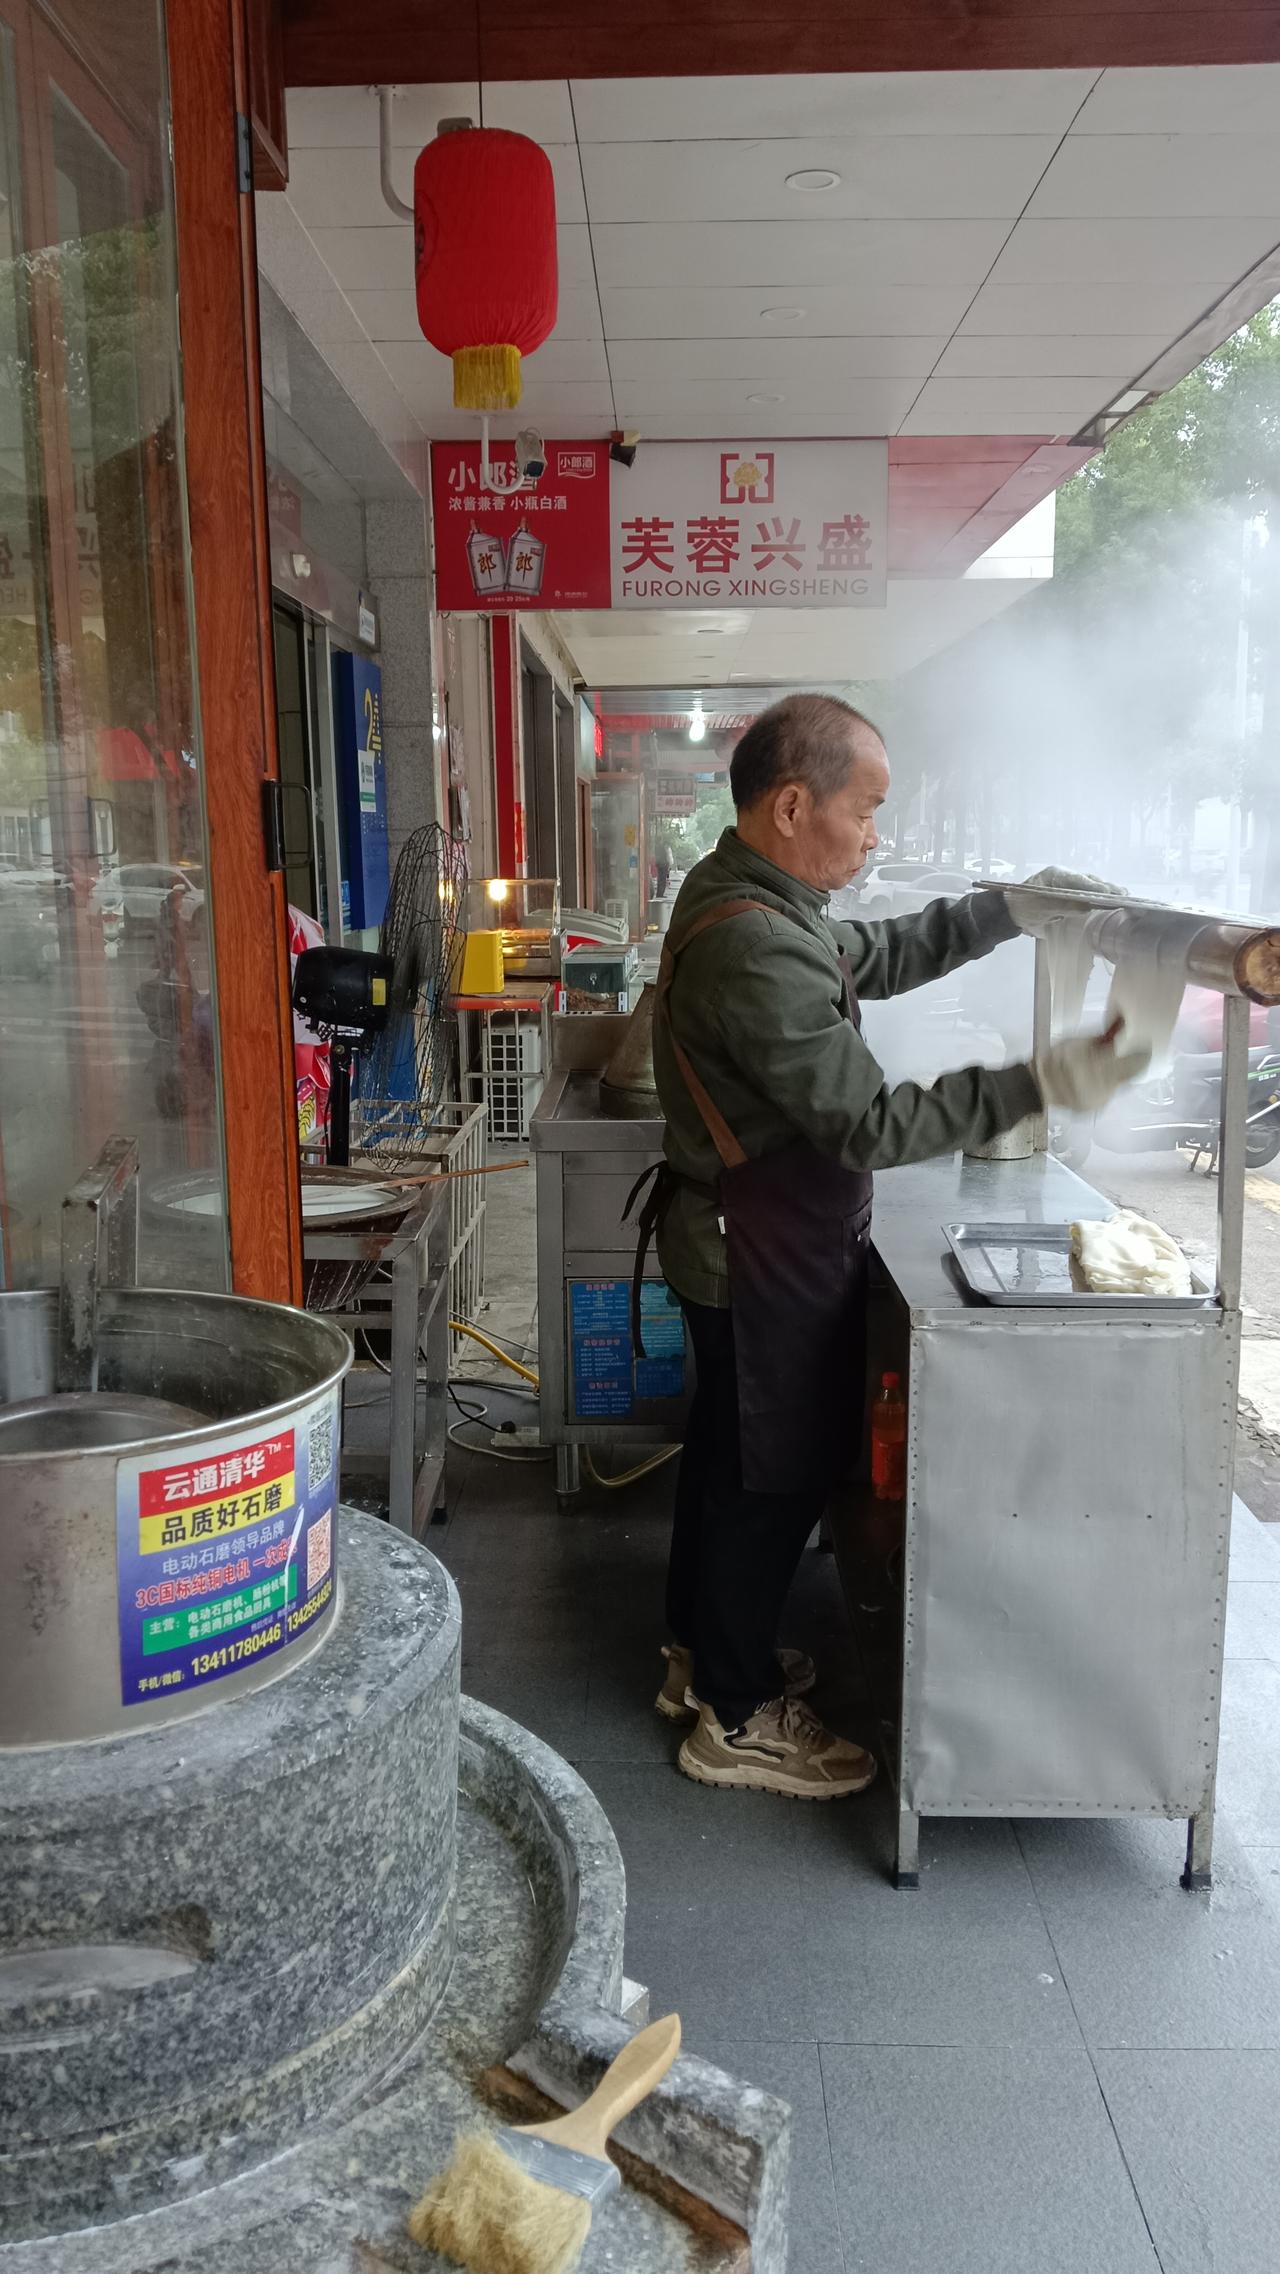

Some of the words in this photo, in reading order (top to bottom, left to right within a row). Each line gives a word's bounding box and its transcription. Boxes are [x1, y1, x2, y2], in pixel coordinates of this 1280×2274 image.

[560, 456, 593, 469] 小郎酒
[449, 496, 505, 511] 浓酱兼香
[510, 496, 567, 510] 小瓶白酒
[621, 514, 873, 574] 芙蓉兴盛
[623, 580, 721, 597] FURONG
[728, 577, 869, 597] XINGSHENG
[163, 1450, 265, 1501] 云通清华
[162, 1483, 282, 1545] 品质好石磨
[163, 1520, 285, 1575] 电动石磨领导品牌
[136, 1559, 250, 1608] 3C国标纯铜电机
[191, 1623, 281, 1676] 13411780446
